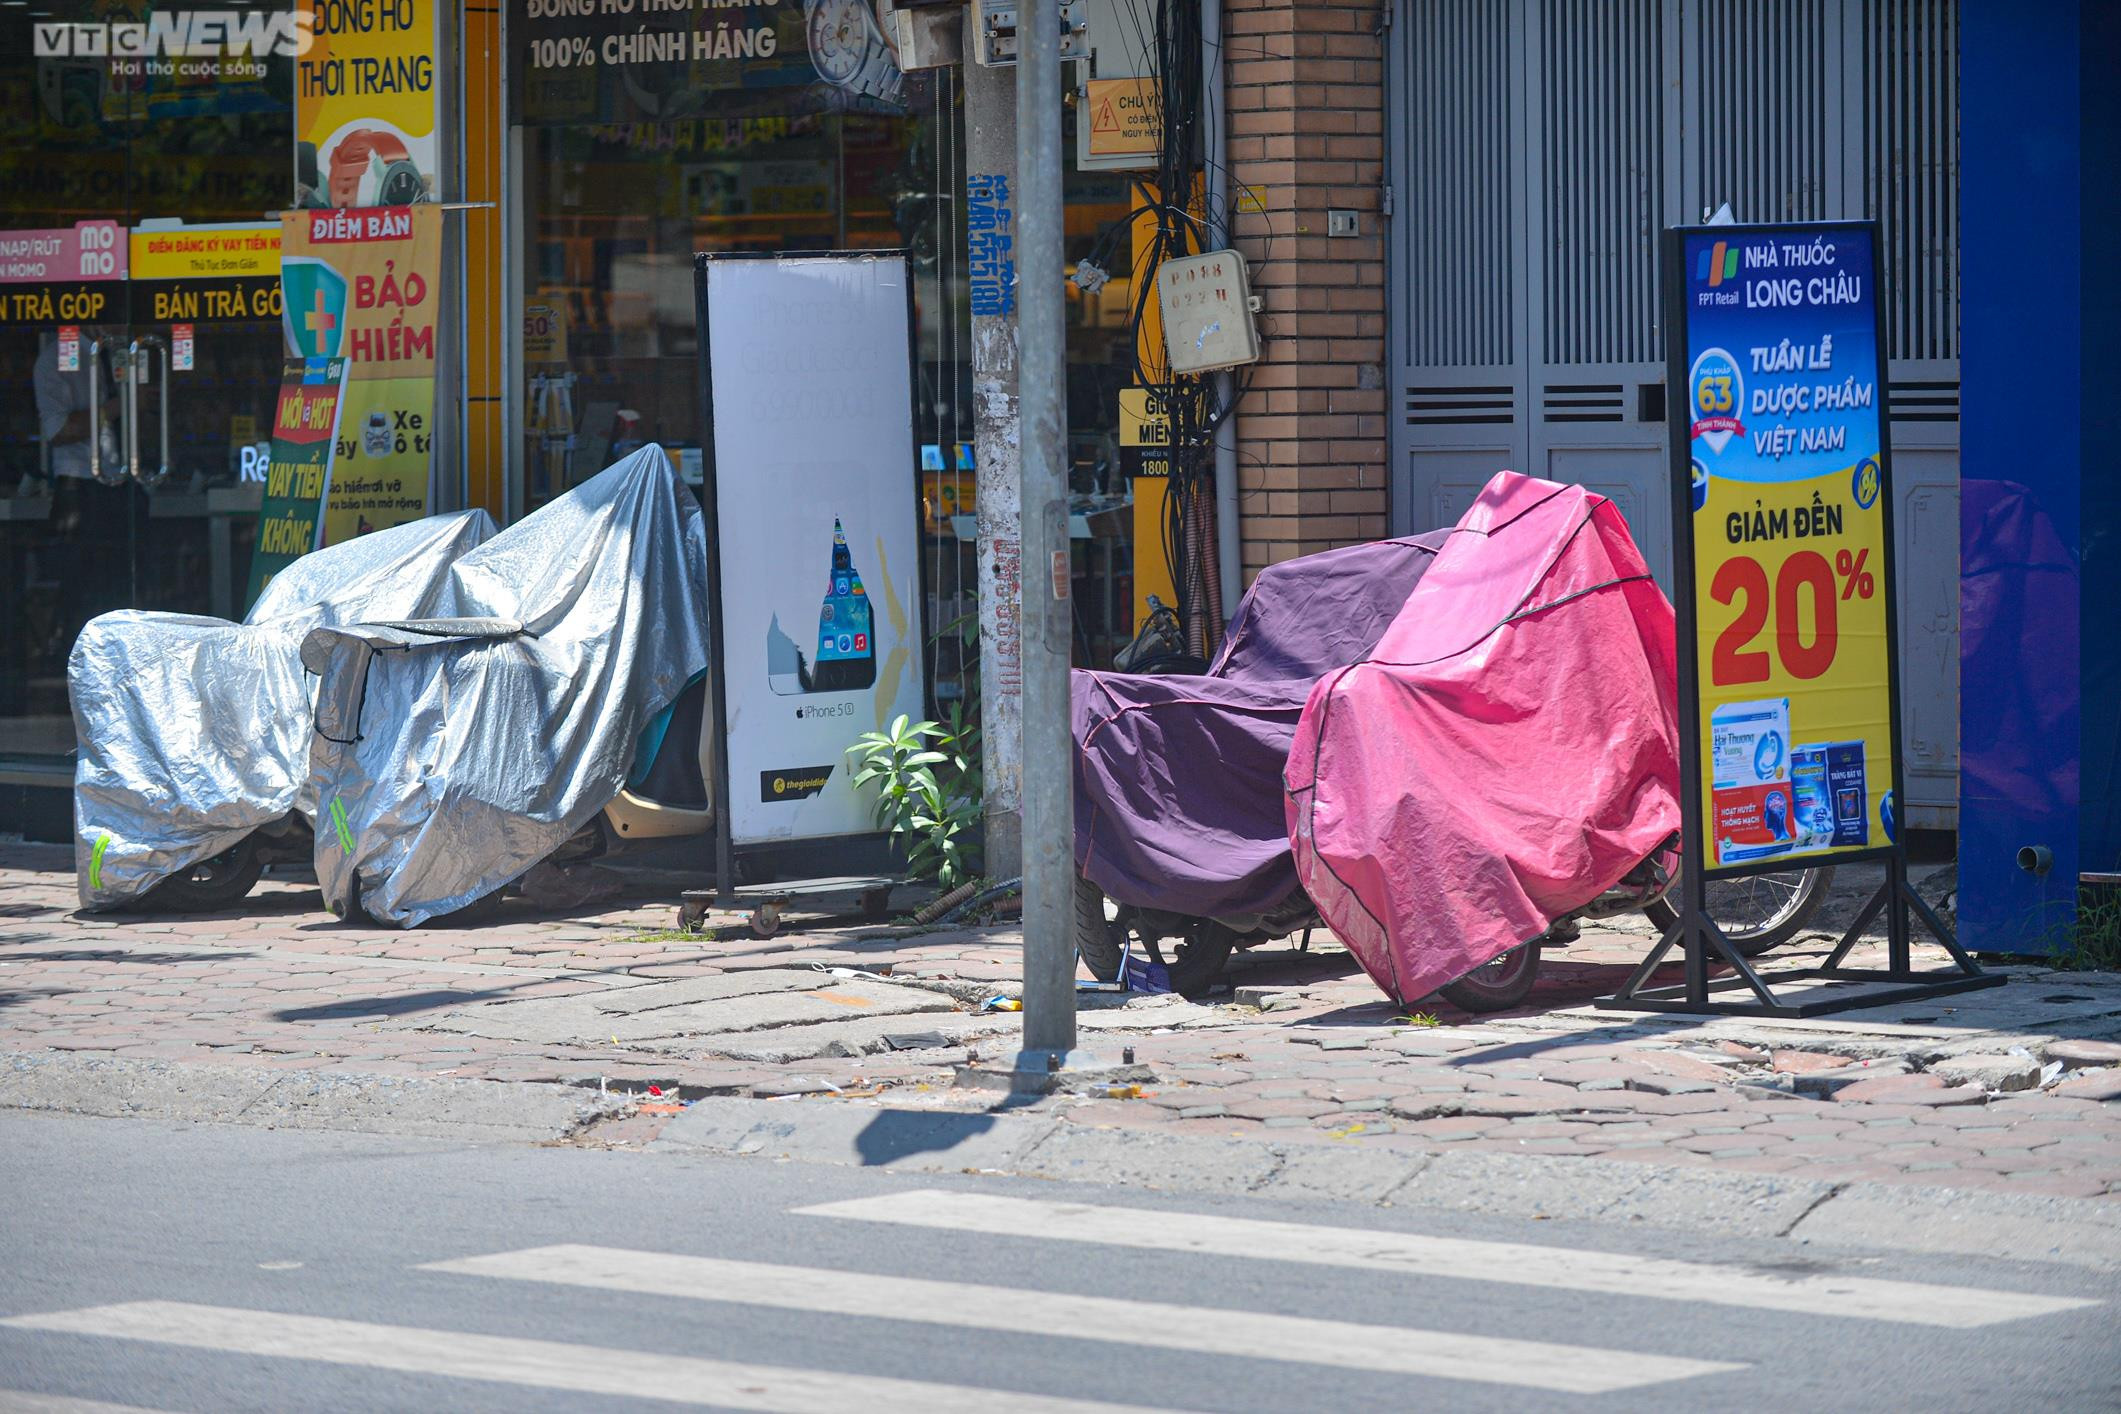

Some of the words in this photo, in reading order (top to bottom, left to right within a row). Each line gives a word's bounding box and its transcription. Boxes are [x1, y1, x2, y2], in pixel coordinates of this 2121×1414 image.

[531, 37, 596, 68] 100%
[602, 25, 686, 64] CHÍNH
[692, 22, 776, 60] HÃNG
[300, 51, 344, 97] THỜI
[351, 55, 433, 95] TRANG
[1122, 129, 1142, 138] NGUY
[313, 208, 362, 240] ĐIỂM
[367, 210, 410, 239] BÁN
[223, 238, 241, 251] VAY
[1745, 240, 1778, 268] NHÀ
[1782, 234, 1836, 267] THUỐC
[8, 262, 46, 277] MOMO
[355, 259, 427, 309] BẢO
[12, 287, 55, 320] TRẢ
[60, 286, 105, 320] GÓP
[155, 285, 198, 320] BÁN
[203, 283, 247, 318] TRẢ
[252, 281, 283, 316] GÓ
[1698, 292, 1713, 305] FPT
[1715, 291, 1740, 305] Retail
[1746, 279, 1803, 308] LONG
[1807, 269, 1861, 305] CHÂU
[350, 309, 434, 362] HIỂM
[1750, 338, 1805, 373] TUẦN
[1808, 334, 1833, 369] LỄ
[1698, 376, 1732, 412] 63
[1752, 382, 1810, 417] DƯỢC
[1814, 375, 1872, 410] PHẨM
[309, 397, 336, 430] HOT
[394, 410, 422, 430] Xe
[335, 435, 357, 460] áy
[395, 433, 407, 454] ô
[1754, 424, 1796, 459] VIỆT
[1800, 426, 1845, 452] NAM
[241, 446, 270, 483] Re
[267, 463, 296, 498] VAY
[1142, 461, 1169, 474] 1800
[329, 478, 341, 493] ảo
[395, 497, 422, 510] rộng
[1726, 500, 1788, 544] GIẢM
[1793, 490, 1843, 537] ĐẾN
[260, 510, 313, 555] KHÔNG
[1710, 548, 1874, 687] 20%
[804, 706, 836, 719] iPhone
